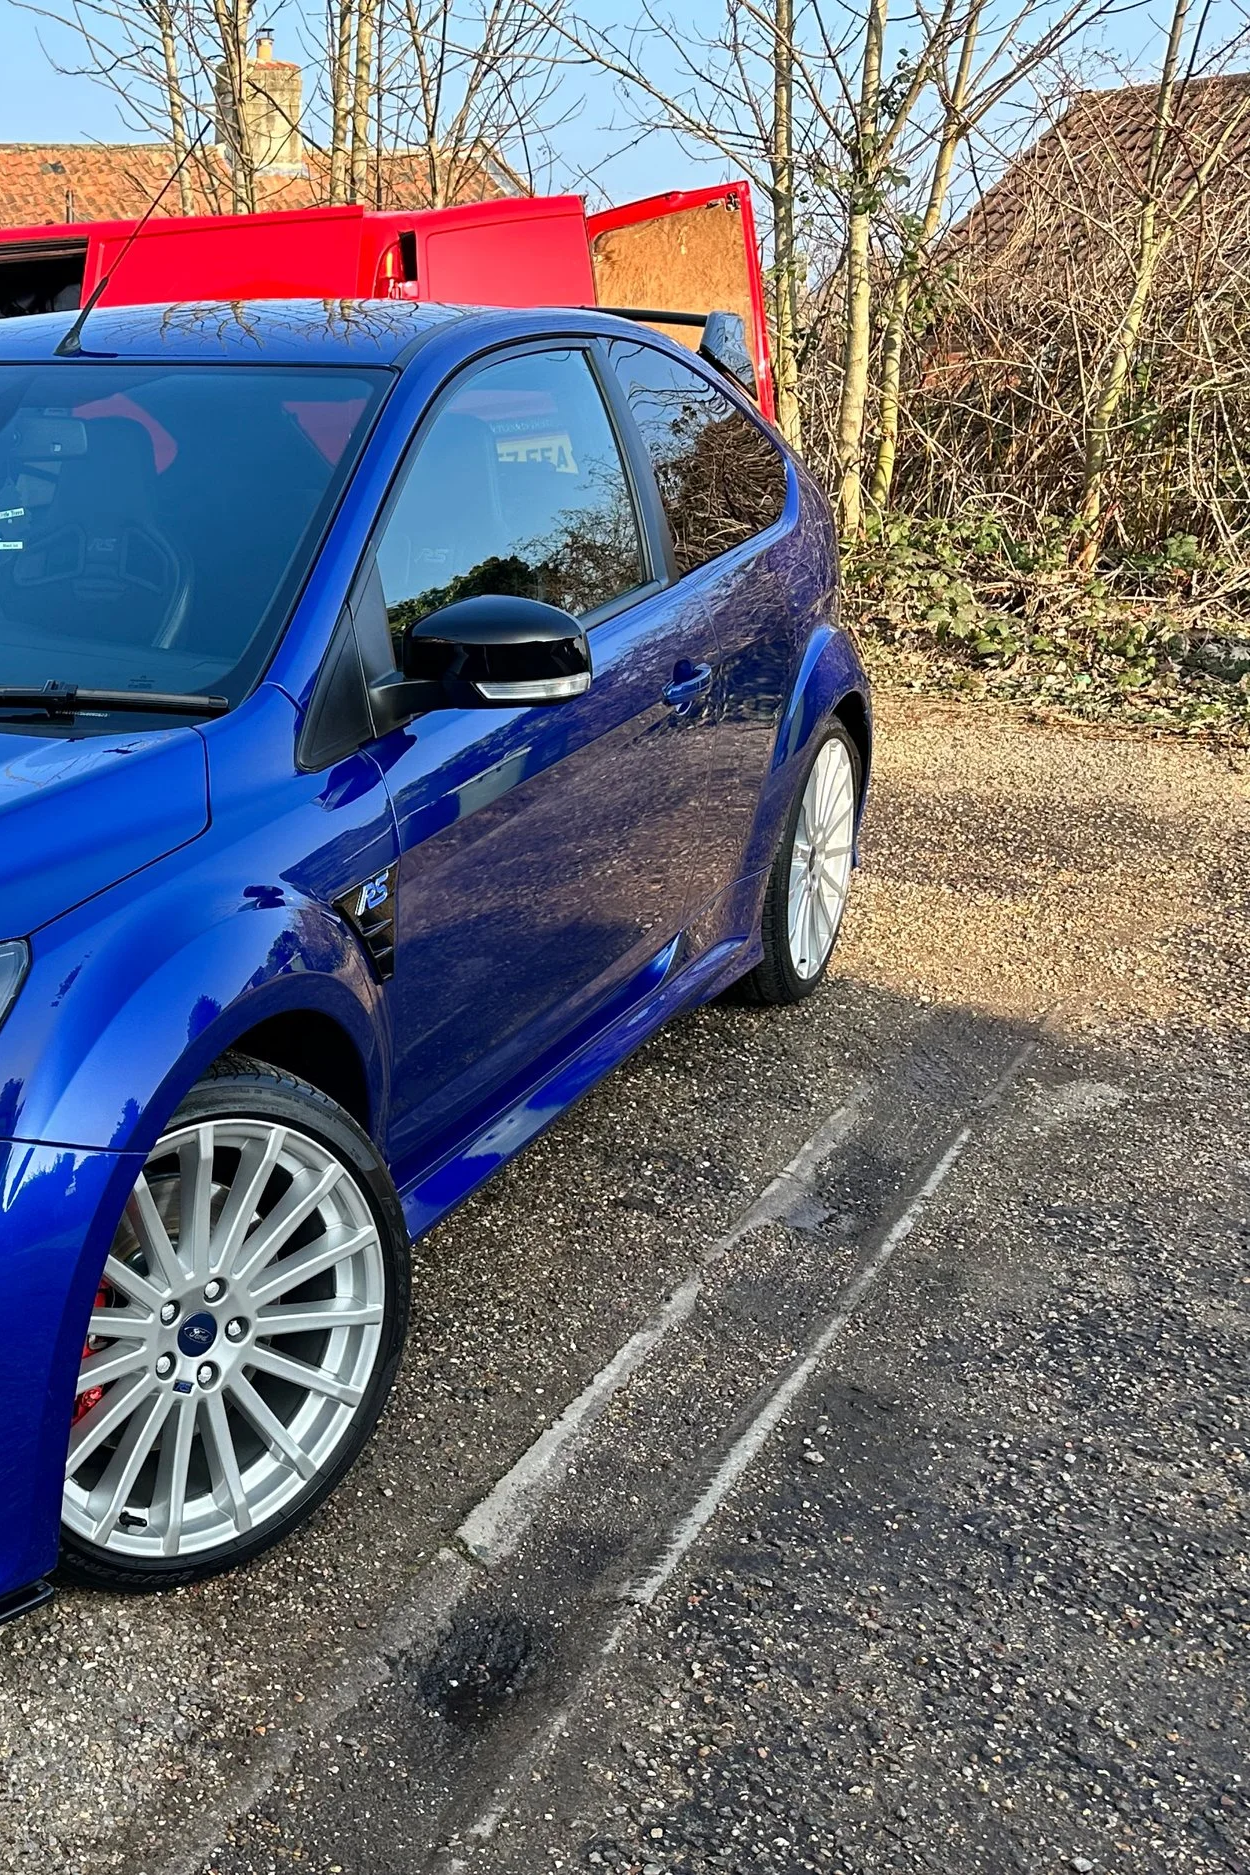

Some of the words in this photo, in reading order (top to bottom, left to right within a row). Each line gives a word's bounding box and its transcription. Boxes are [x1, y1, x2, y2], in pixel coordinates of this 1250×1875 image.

[87, 538, 117, 551] RS
[414, 548, 449, 563] RS
[354, 869, 389, 916] RS
[189, 1327, 210, 1342] Ford
[174, 1381, 191, 1392] RS
